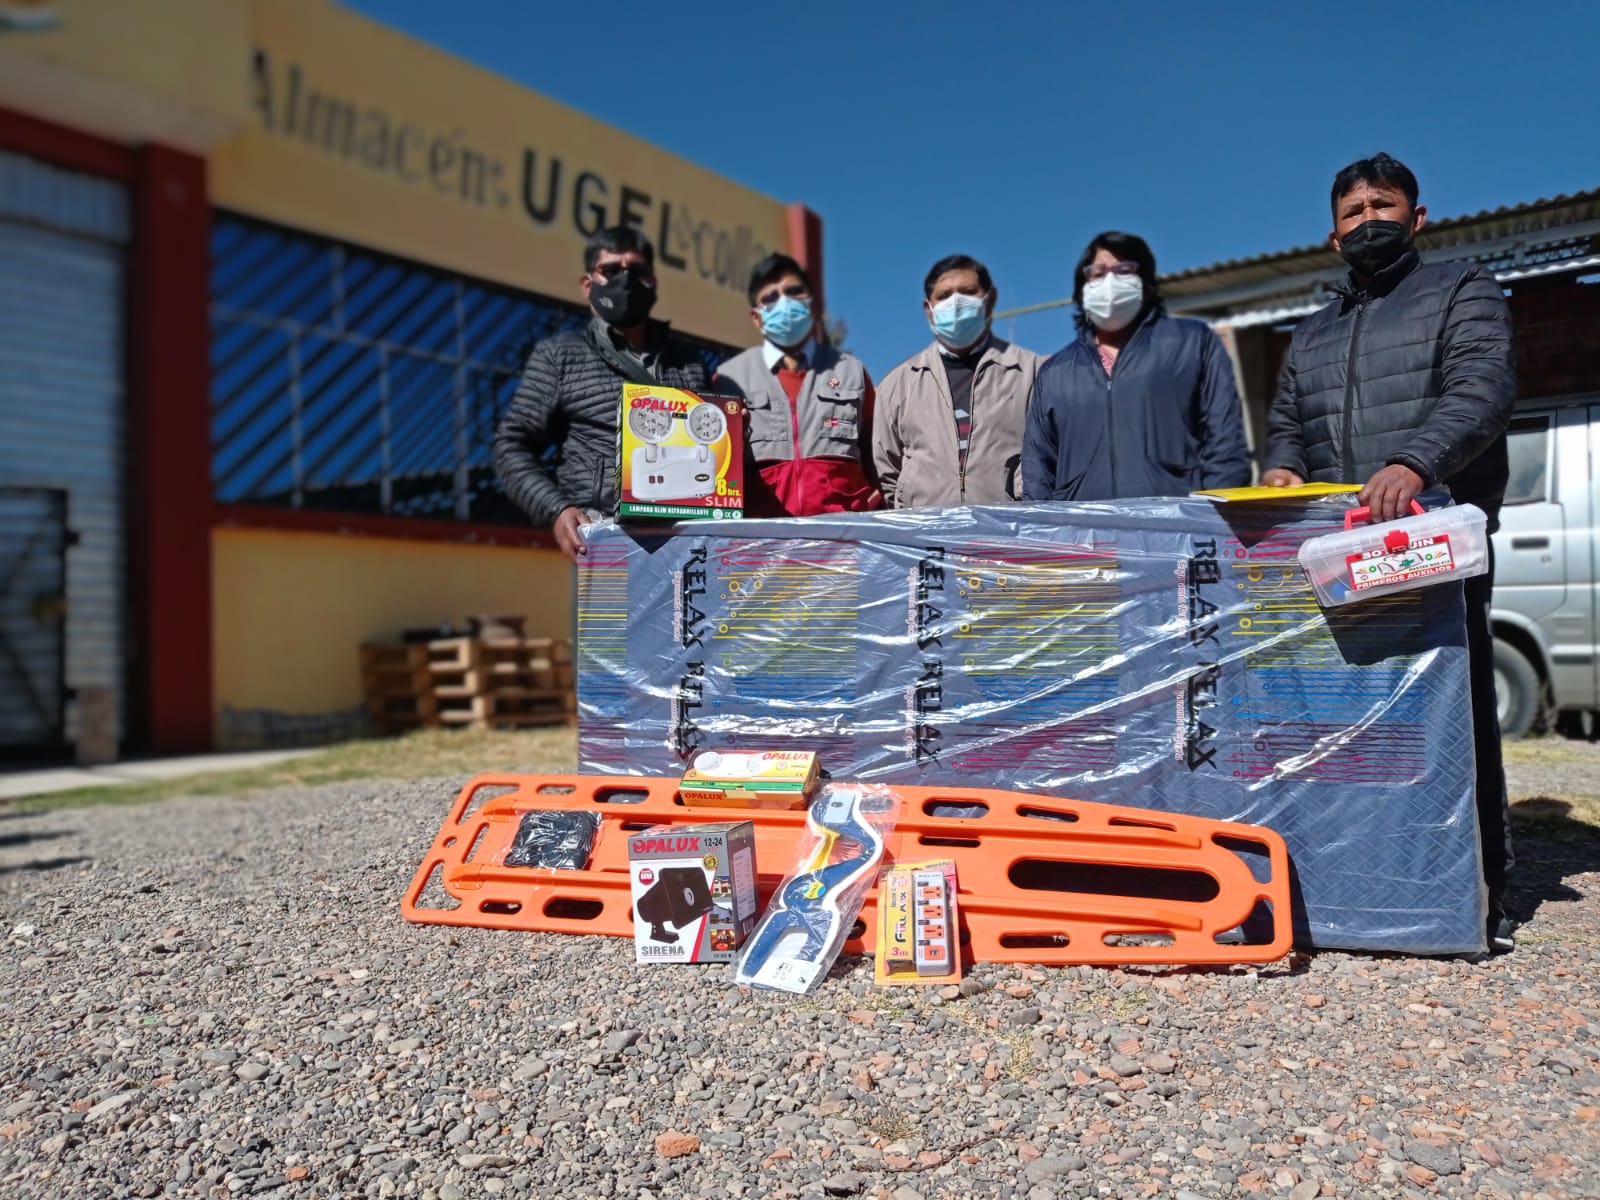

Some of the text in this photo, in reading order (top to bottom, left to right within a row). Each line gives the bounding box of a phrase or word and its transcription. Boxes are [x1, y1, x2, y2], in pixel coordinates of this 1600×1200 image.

[522, 147, 687, 271] UGEL
[630, 397, 689, 412] OPALUX
[716, 478, 727, 496] 8
[705, 496, 742, 507] SLIM
[1356, 565, 1452, 590] PRIMEROS AUXILIOS
[683, 546, 707, 649] RELAX
[917, 546, 945, 650] RELAX
[1189, 538, 1220, 647] RELAX
[762, 752, 811, 760] OPALUX
[684, 792, 724, 800] OPALUX
[632, 837, 723, 854] OPALUX 12-24
[641, 945, 685, 956] SIRENA
